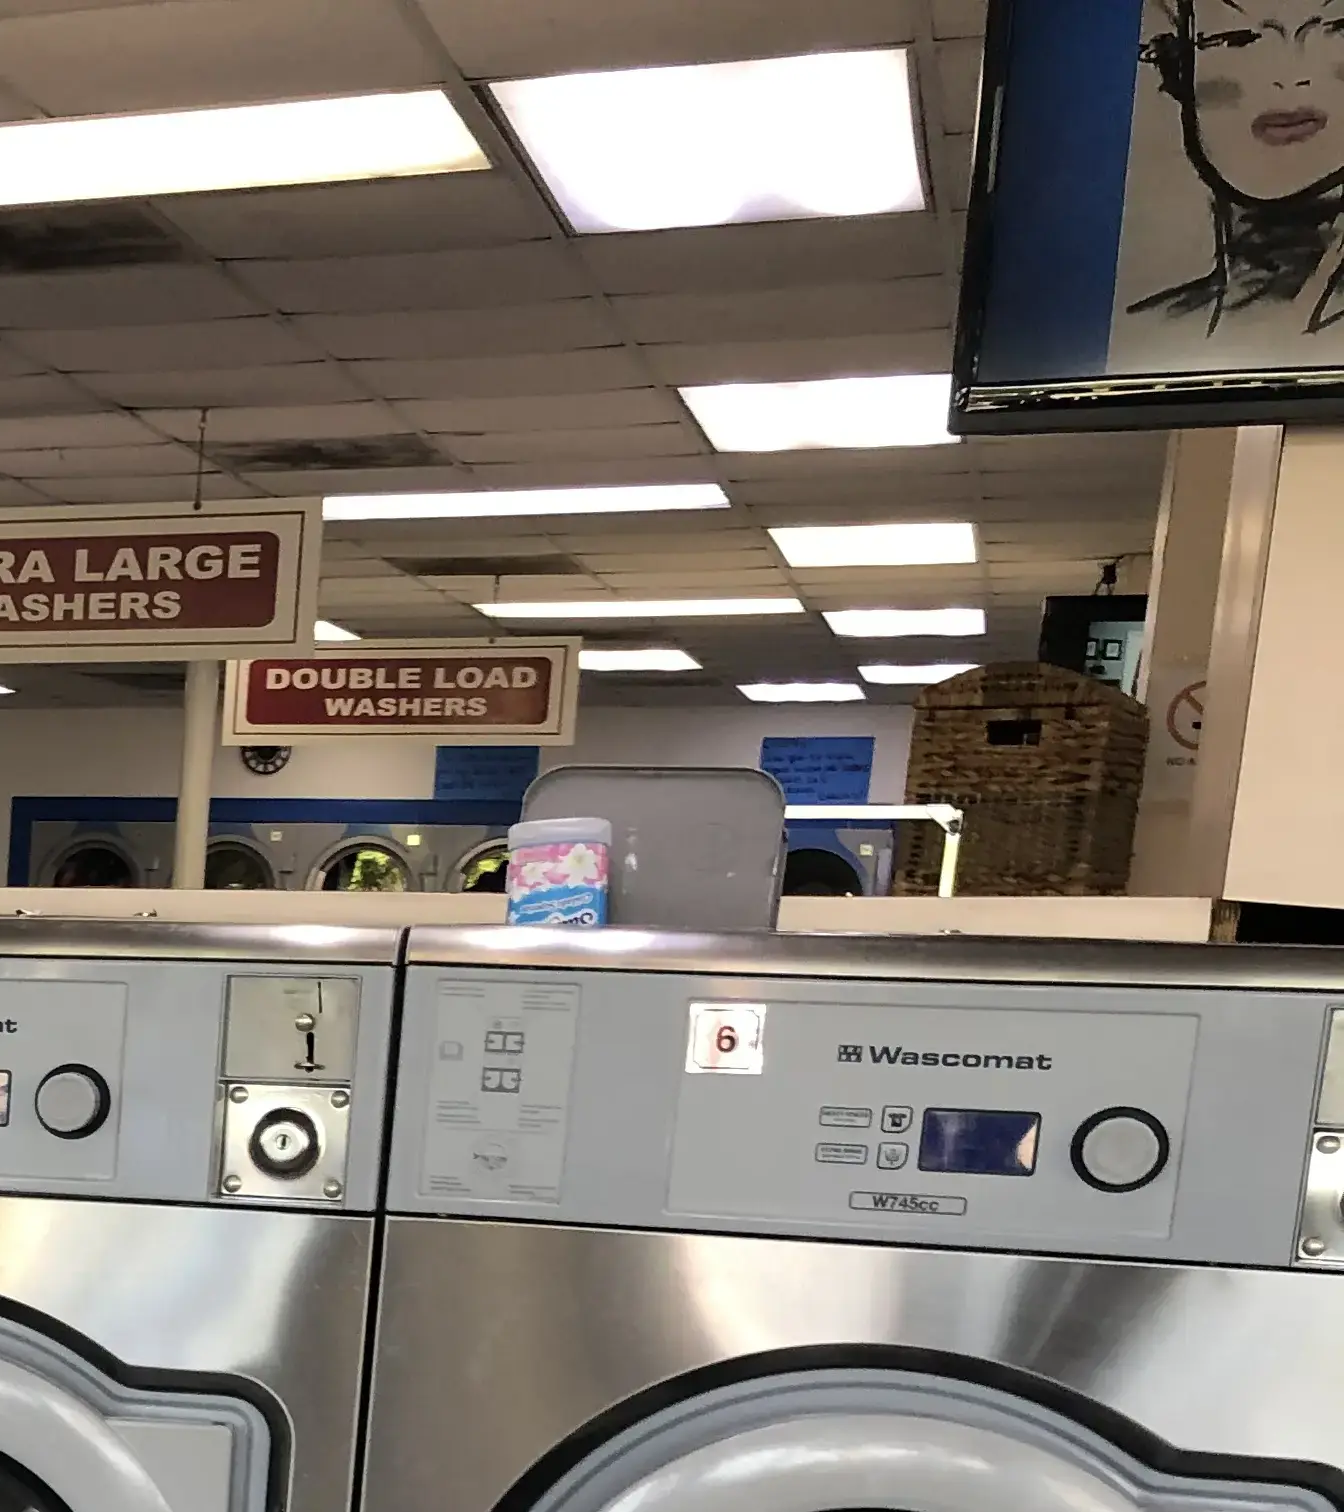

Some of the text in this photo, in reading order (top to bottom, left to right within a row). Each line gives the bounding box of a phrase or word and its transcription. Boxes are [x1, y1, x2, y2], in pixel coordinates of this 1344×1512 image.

[73, 544, 262, 582] LARGE
[265, 667, 538, 690] DOUBLE LOAD
[324, 697, 488, 718] WASHERS
[716, 1025, 737, 1053] 6
[869, 1044, 1052, 1071] Wascomat
[872, 1195, 940, 1213] W745cc
